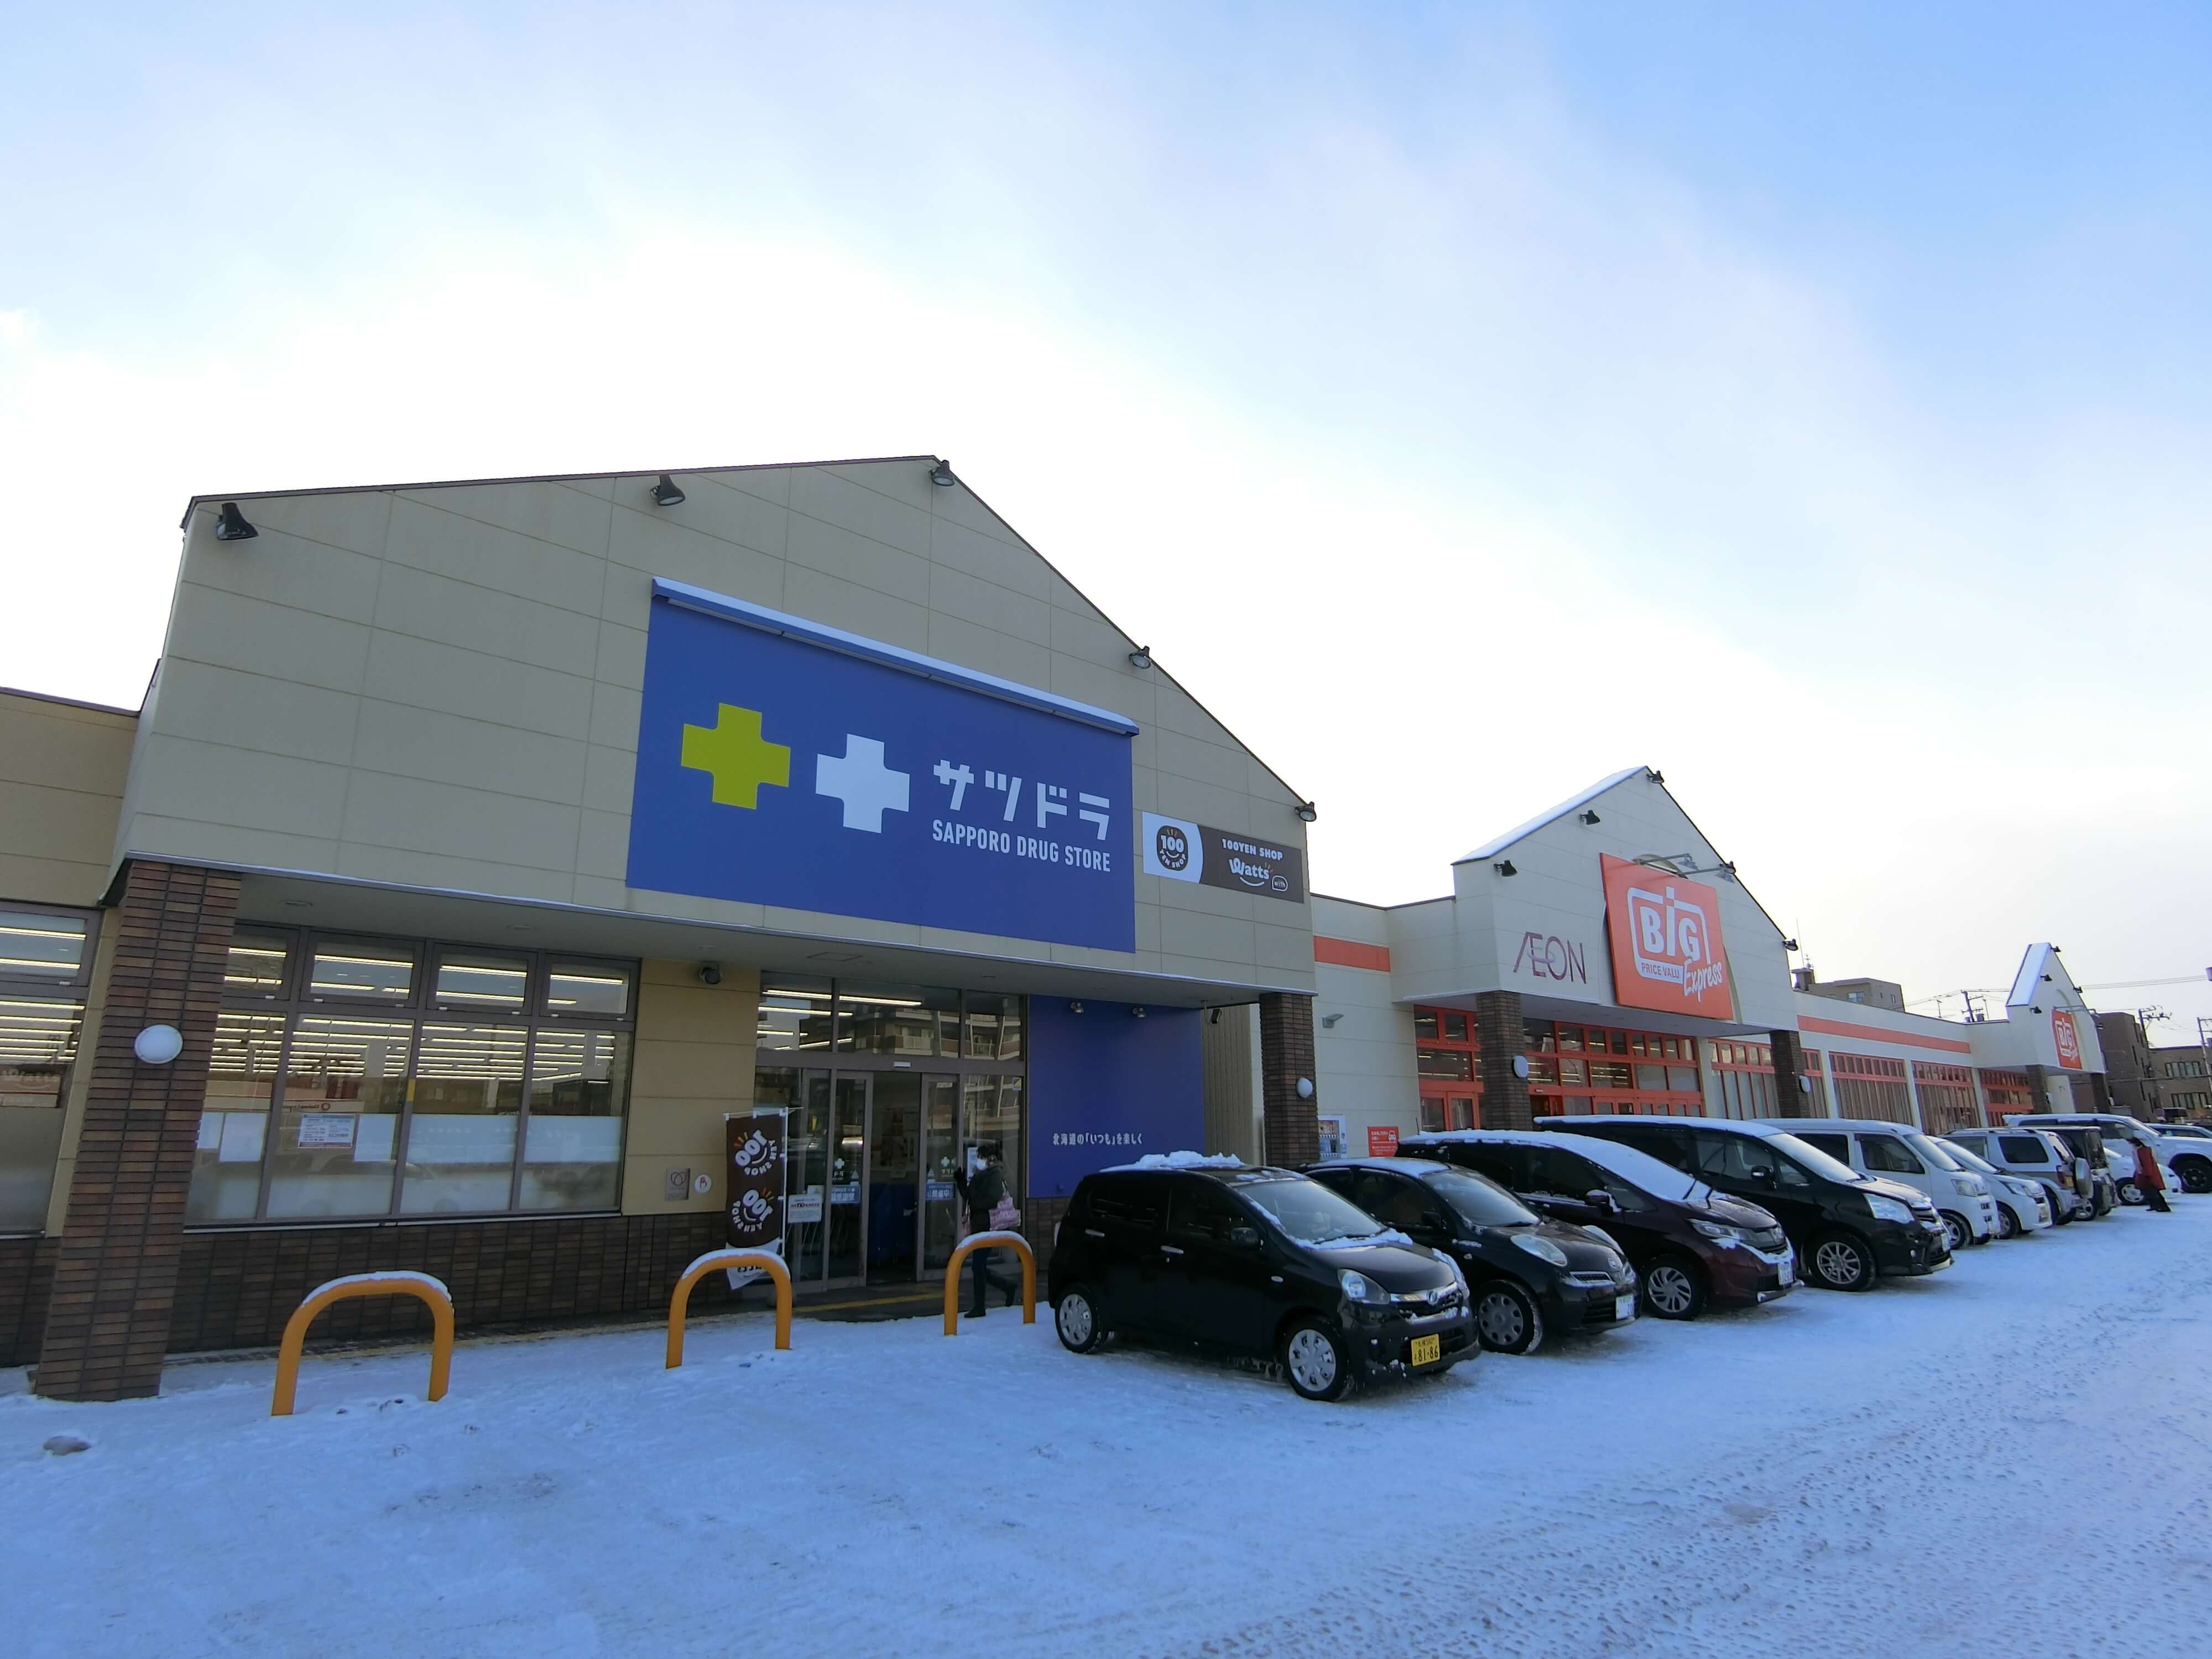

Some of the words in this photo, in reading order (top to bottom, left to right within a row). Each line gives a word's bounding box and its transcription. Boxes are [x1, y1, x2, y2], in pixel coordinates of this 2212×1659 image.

[933, 759, 1110, 841] サツドラ
[932, 820, 1011, 854] SAPPORO
[1016, 836, 1059, 863] DRUG
[1065, 845, 1110, 872] STORE
[1161, 834, 1184, 853] 100
[1222, 838, 1256, 855] 100YEN
[1259, 847, 1284, 861] SHOP
[1159, 849, 1171, 866] YEN
[1172, 853, 1186, 868] SHOP
[1228, 857, 1270, 880] Watts
[1274, 880, 1286, 888] with
[1641, 962, 1662, 975] PRICE
[1662, 966, 1679, 979] VALU
[1683, 958, 1723, 1002] Express
[1052, 1132, 1142, 1145] 北海道の「いつも」を楽しく
[1418, 1345, 1438, 1362] 81-86
